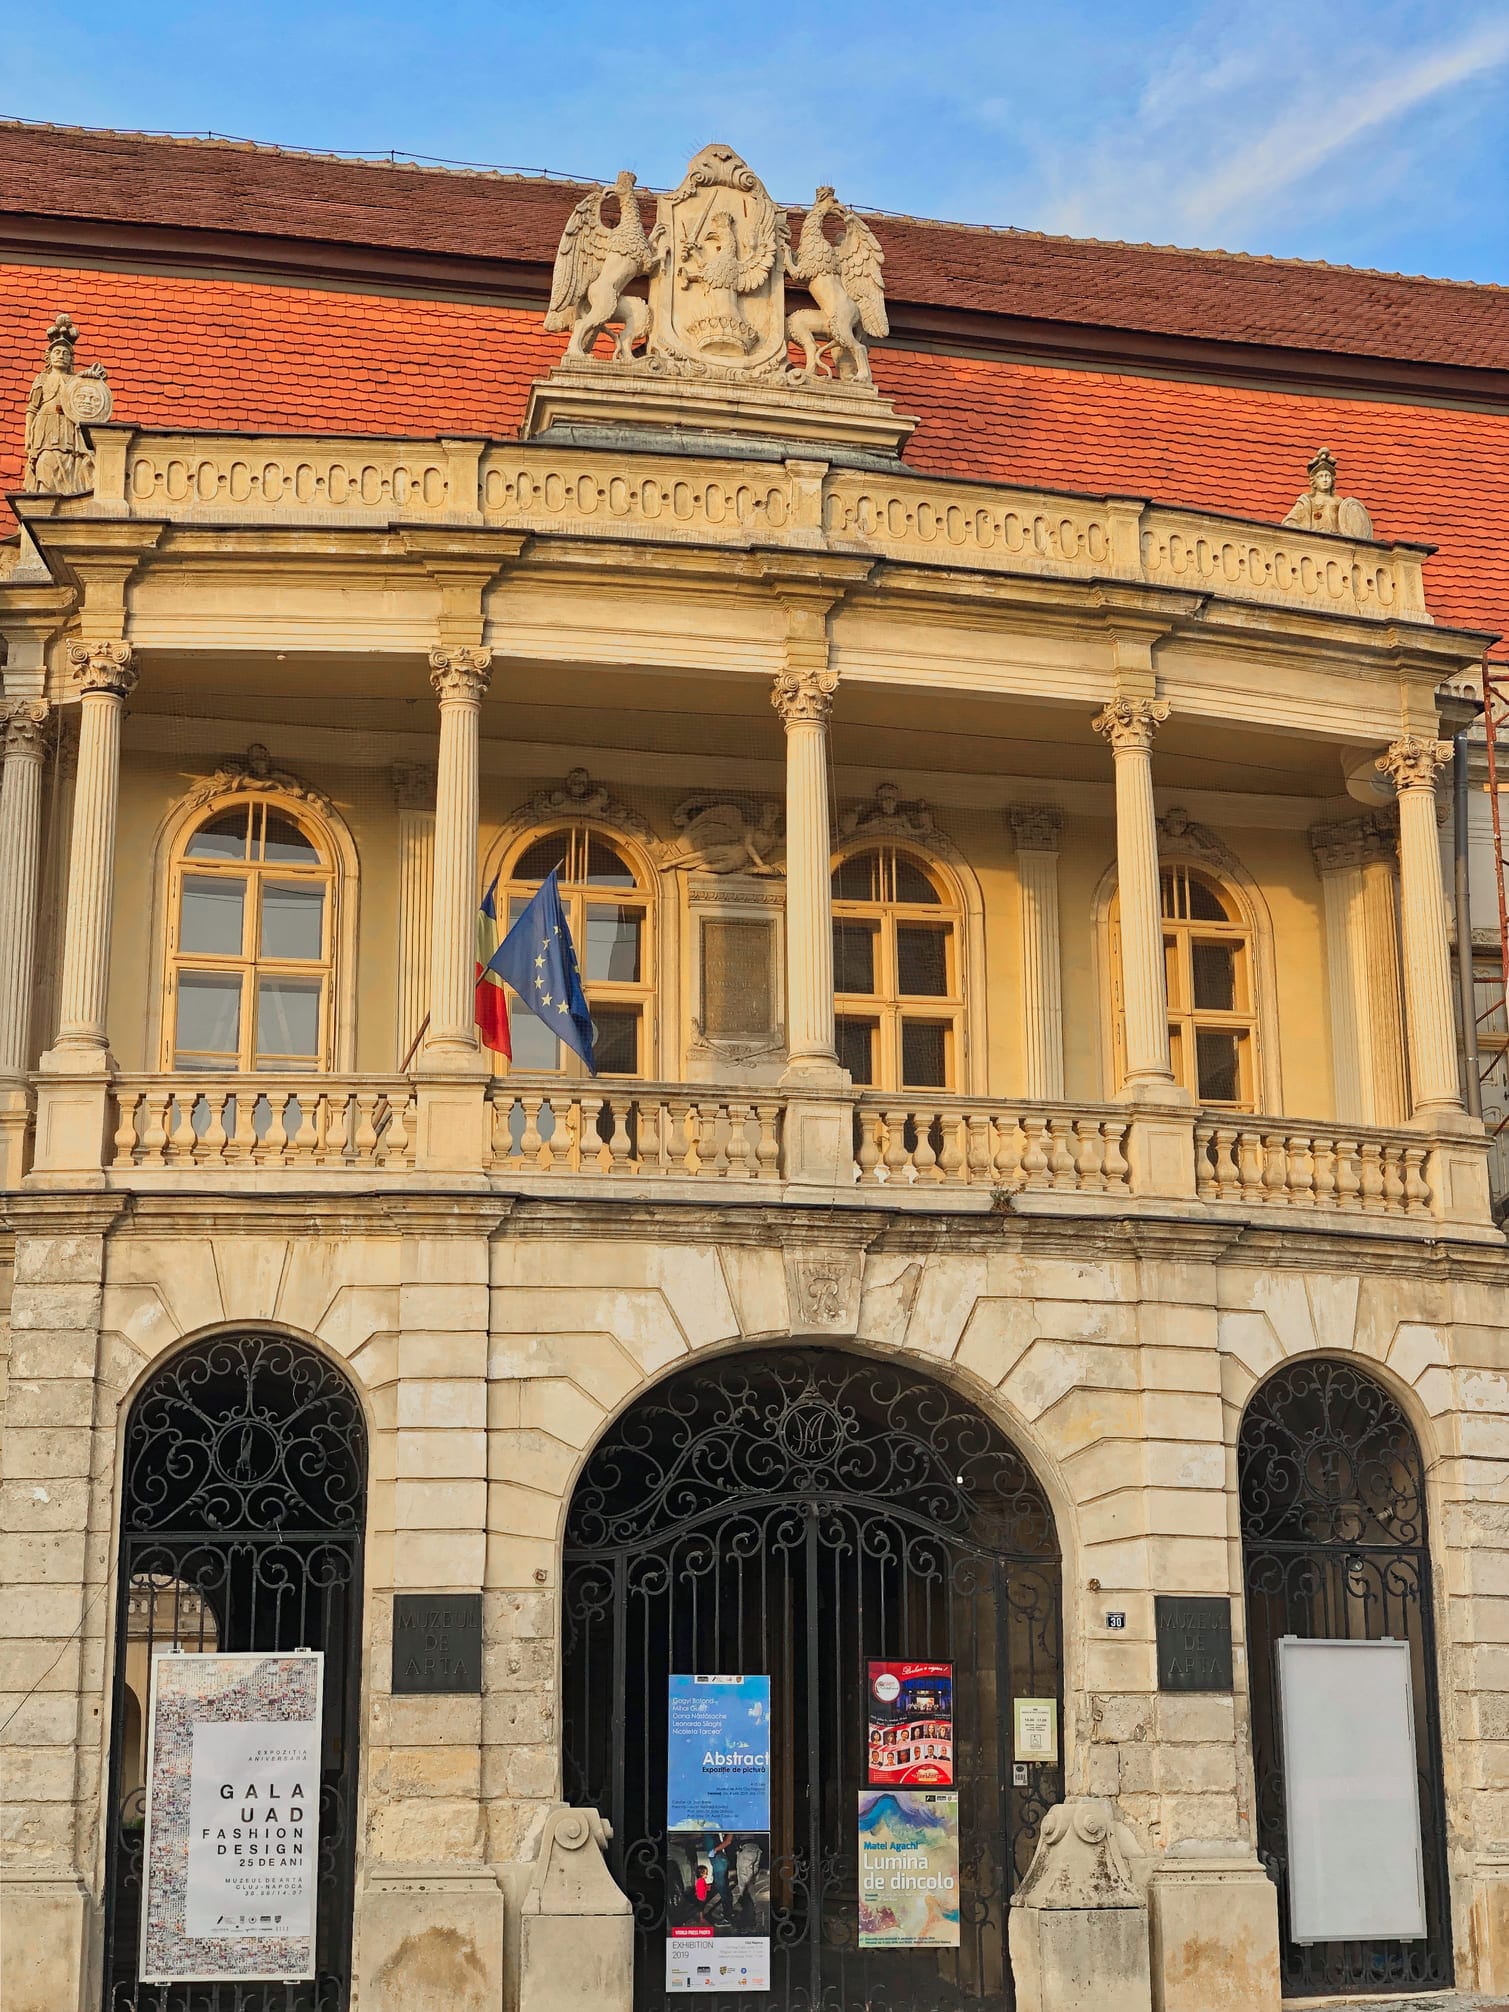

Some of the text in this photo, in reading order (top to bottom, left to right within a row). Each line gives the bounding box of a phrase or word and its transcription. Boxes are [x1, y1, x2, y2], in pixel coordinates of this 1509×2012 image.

[398, 1609, 480, 1630] MUZEUL
[1110, 1617, 1122, 1627] 30
[424, 1634, 449, 1652] DE
[1184, 1635, 1205, 1651] DE
[702, 1751, 769, 1766] Abstract
[220, 1784, 304, 1799] GALA
[241, 1807, 303, 1823] UAD
[202, 1828, 303, 1839] FASHION
[217, 1844, 303, 1855] DESIGN
[864, 1841, 919, 1852] Matei Agachi
[239, 1858, 303, 1867] 25 DE ANI
[863, 1852, 929, 1870] Lumina
[863, 1871, 954, 1890] de dincolo
[672, 1941, 714, 1949] EXHIBITION
[672, 1951, 689, 1959] 2019
